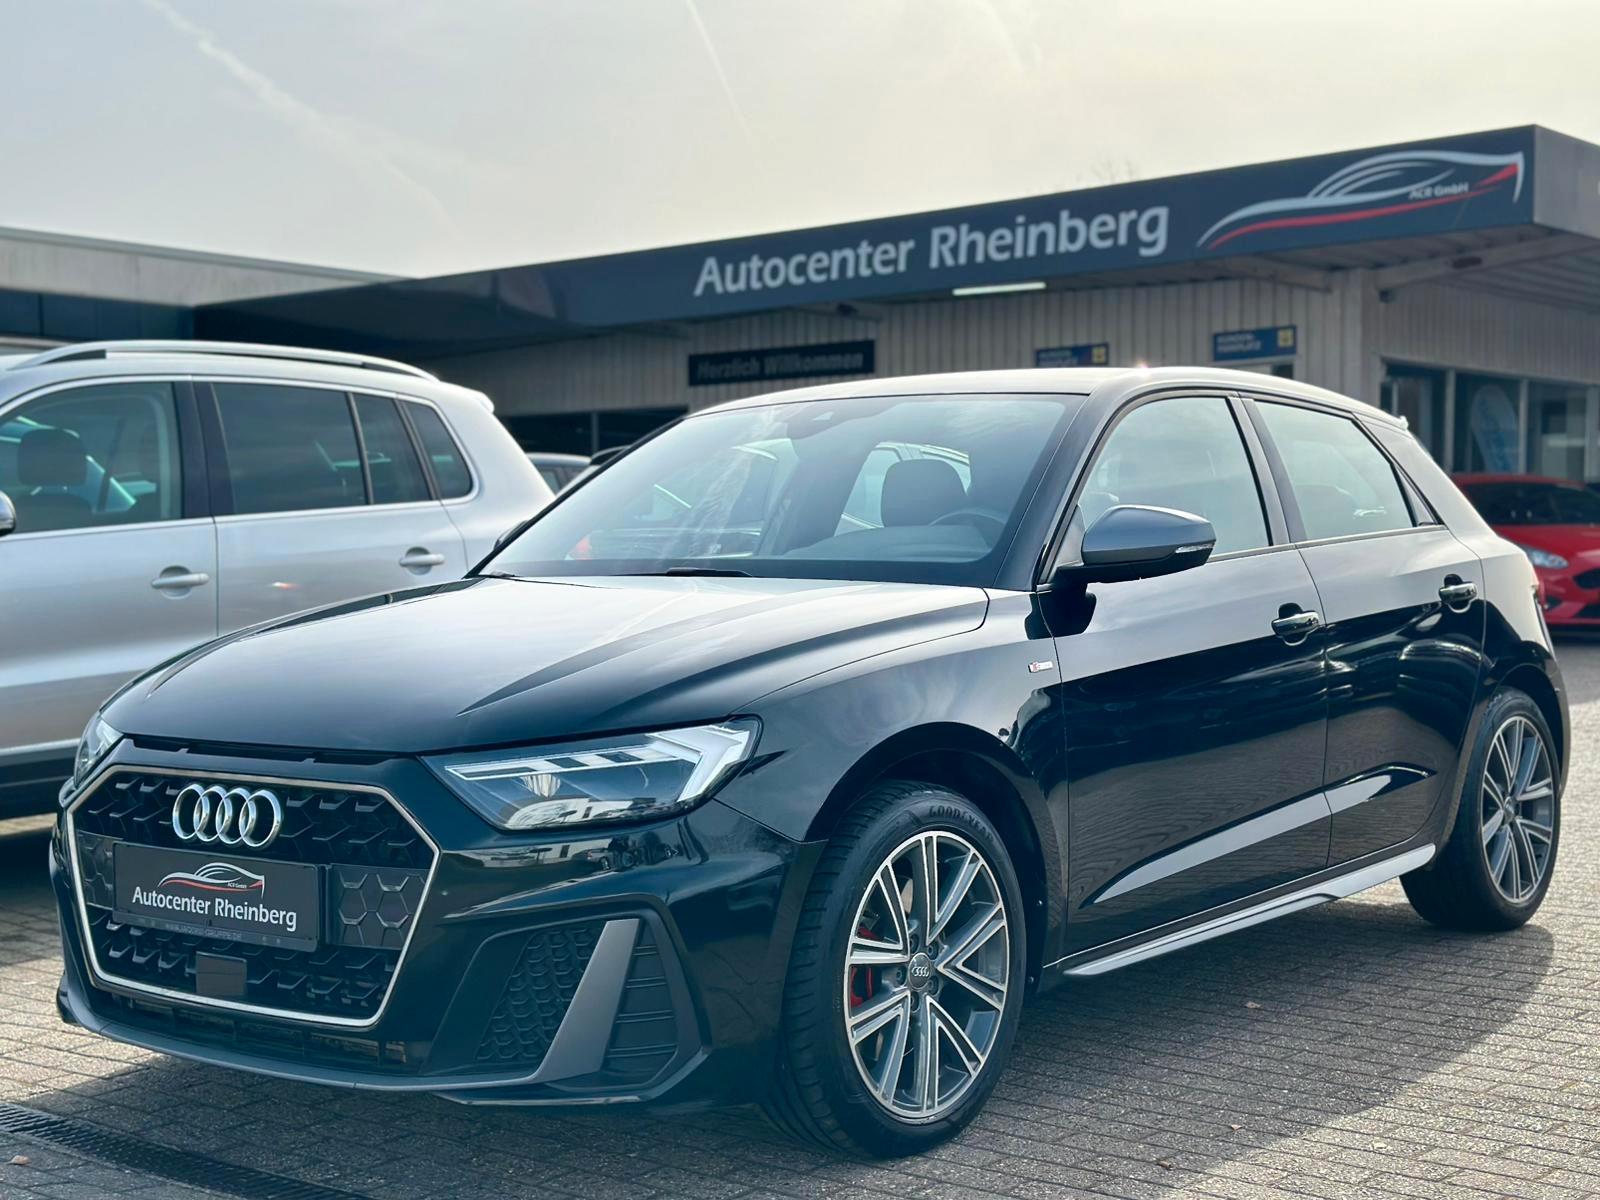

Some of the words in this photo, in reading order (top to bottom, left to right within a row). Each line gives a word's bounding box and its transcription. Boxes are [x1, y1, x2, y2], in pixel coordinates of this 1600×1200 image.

[1434, 182, 1469, 198] GmbH
[694, 237, 915, 297] Autocenter
[929, 206, 1170, 269] Rheinberg
[132, 886, 211, 915] Autocenter
[214, 898, 297, 932] Rheinberg
